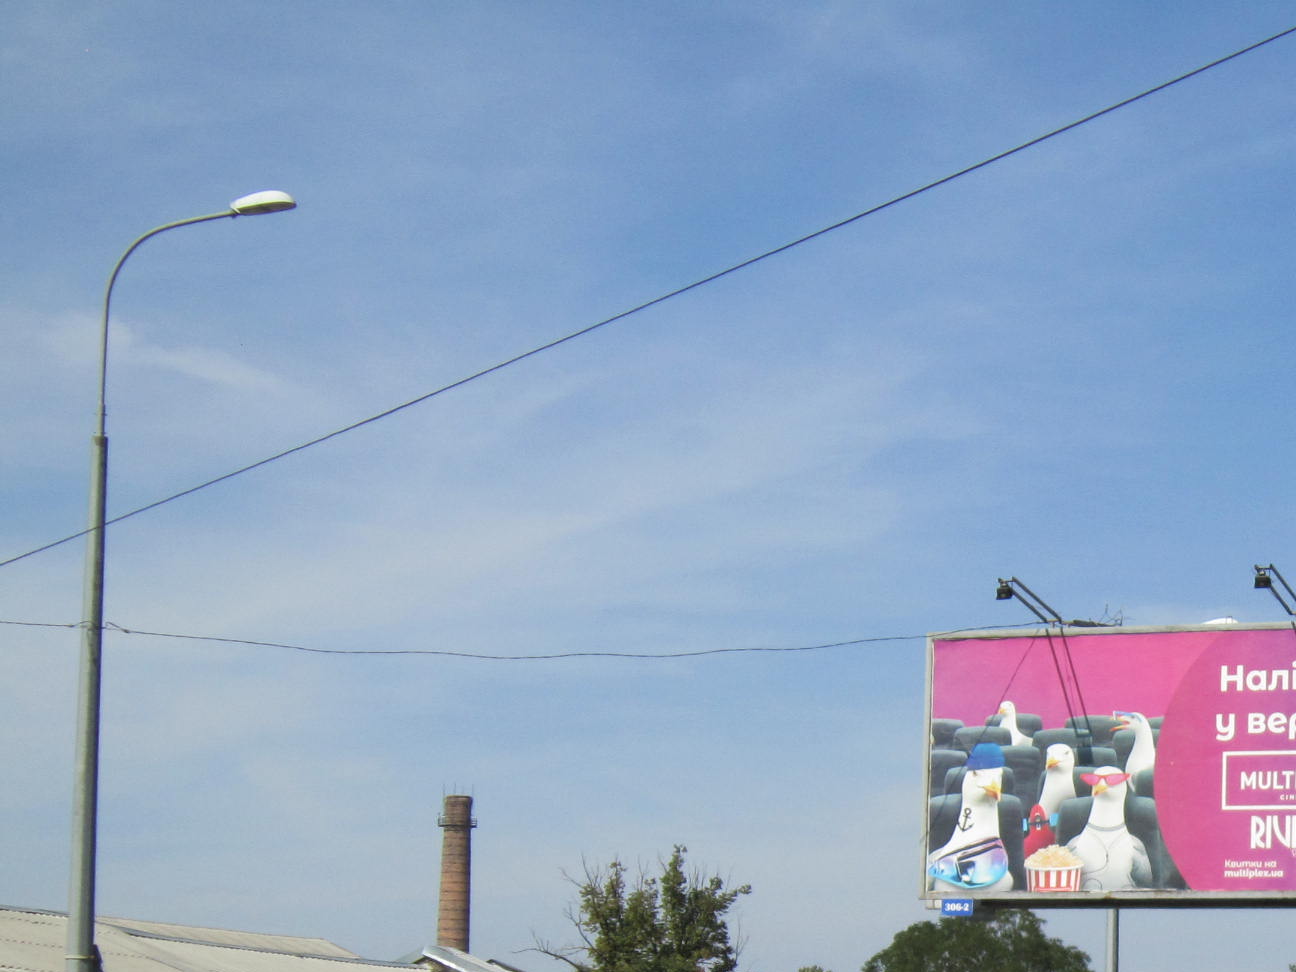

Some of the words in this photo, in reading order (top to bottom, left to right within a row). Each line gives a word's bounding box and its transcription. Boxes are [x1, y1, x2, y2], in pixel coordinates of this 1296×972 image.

[1216, 713, 1235, 741] у
[1224, 859, 1262, 869] Квитки
[1264, 860, 1277, 868] на
[1224, 868, 1284, 879] multiplex.ua
